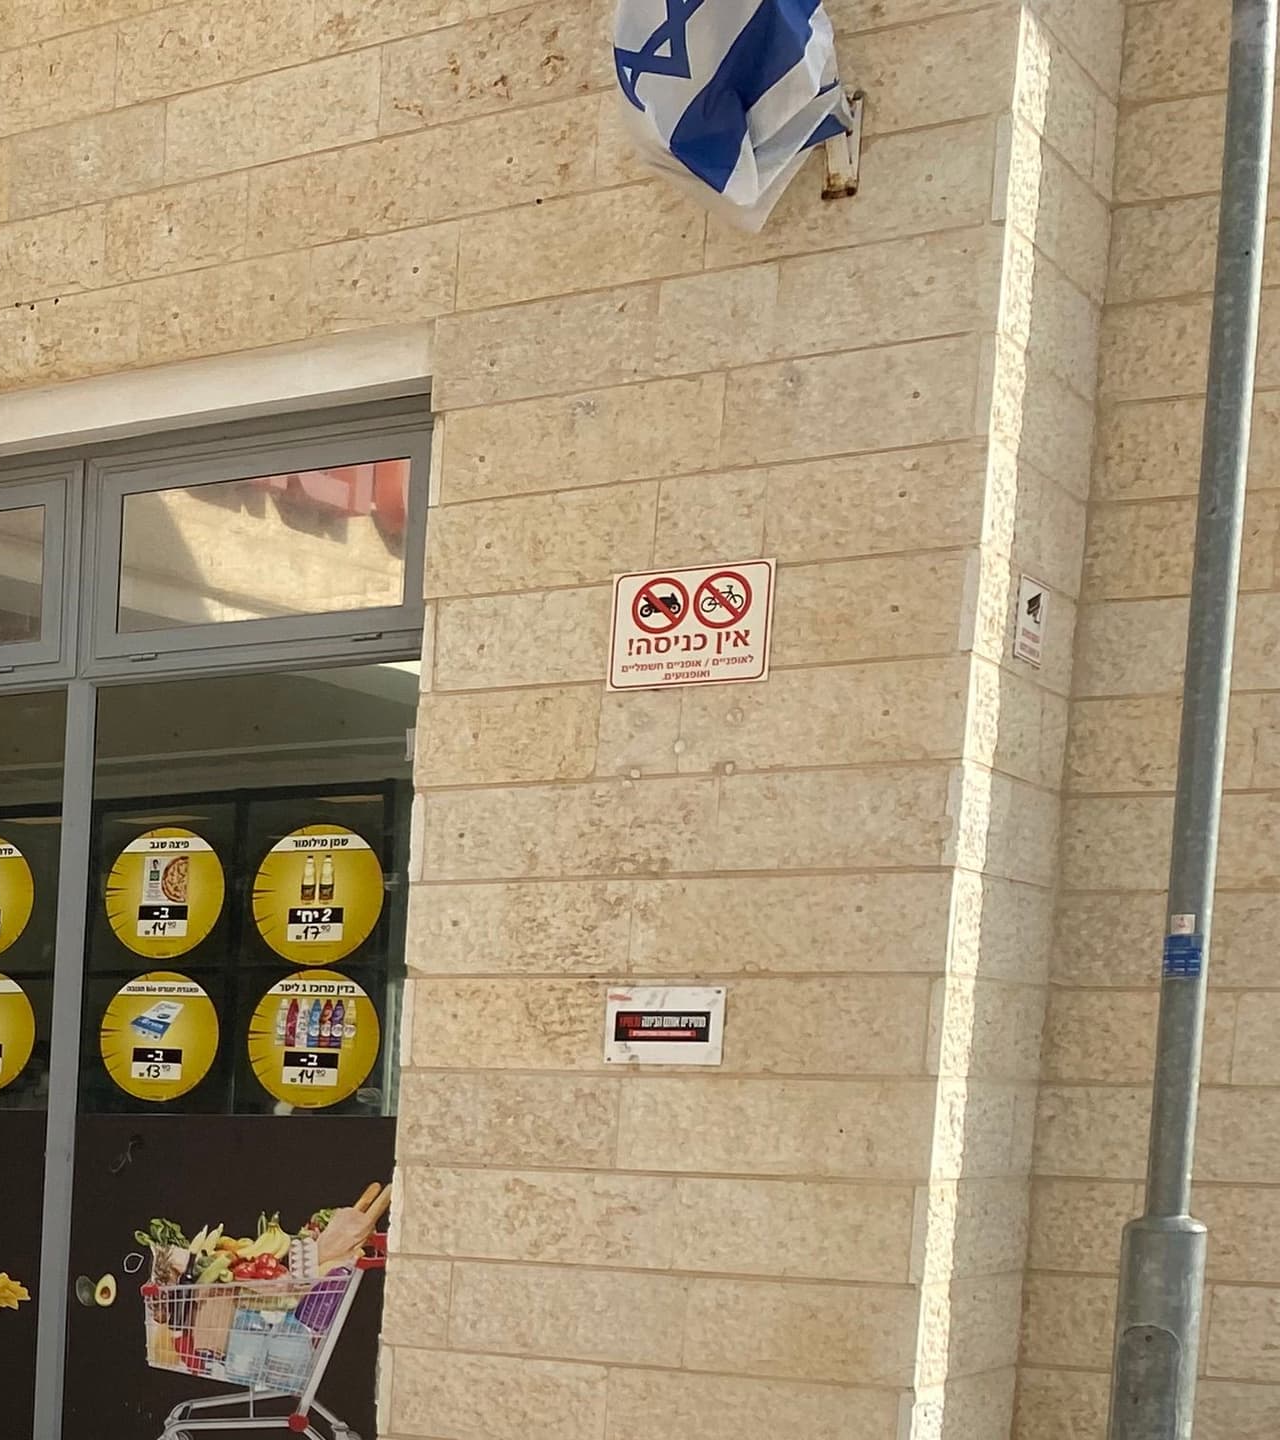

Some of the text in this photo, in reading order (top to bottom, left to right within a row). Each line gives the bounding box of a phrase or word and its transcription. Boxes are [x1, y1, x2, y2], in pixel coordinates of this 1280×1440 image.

[628, 630, 750, 656] אין כניסה!
[666, 659, 702, 670] אופניים
[712, 654, 754, 667] לאופניים
[621, 662, 664, 673] חשמליים
[169, 841, 190, 849] פיצה
[330, 838, 348, 849] שמן
